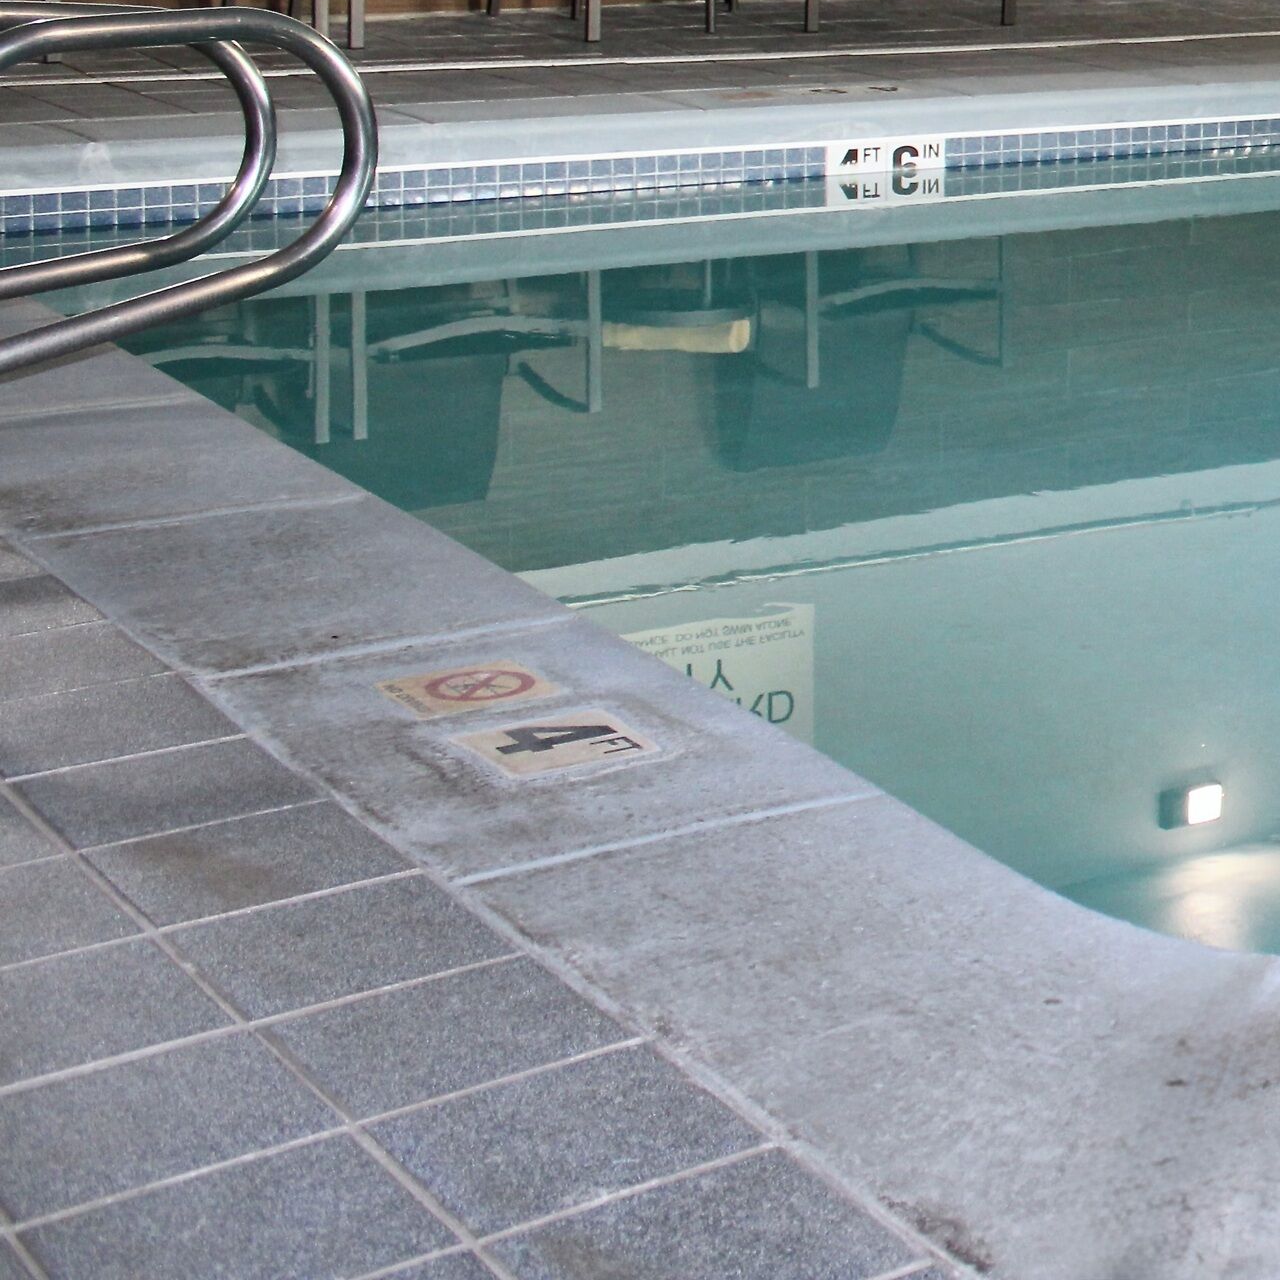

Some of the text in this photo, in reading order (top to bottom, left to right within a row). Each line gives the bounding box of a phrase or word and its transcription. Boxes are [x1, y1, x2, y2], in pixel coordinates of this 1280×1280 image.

[863, 147, 881, 163] FT
[922, 143, 940, 159] IN
[383, 684, 404, 694] NO
[495, 724, 618, 756] 4
